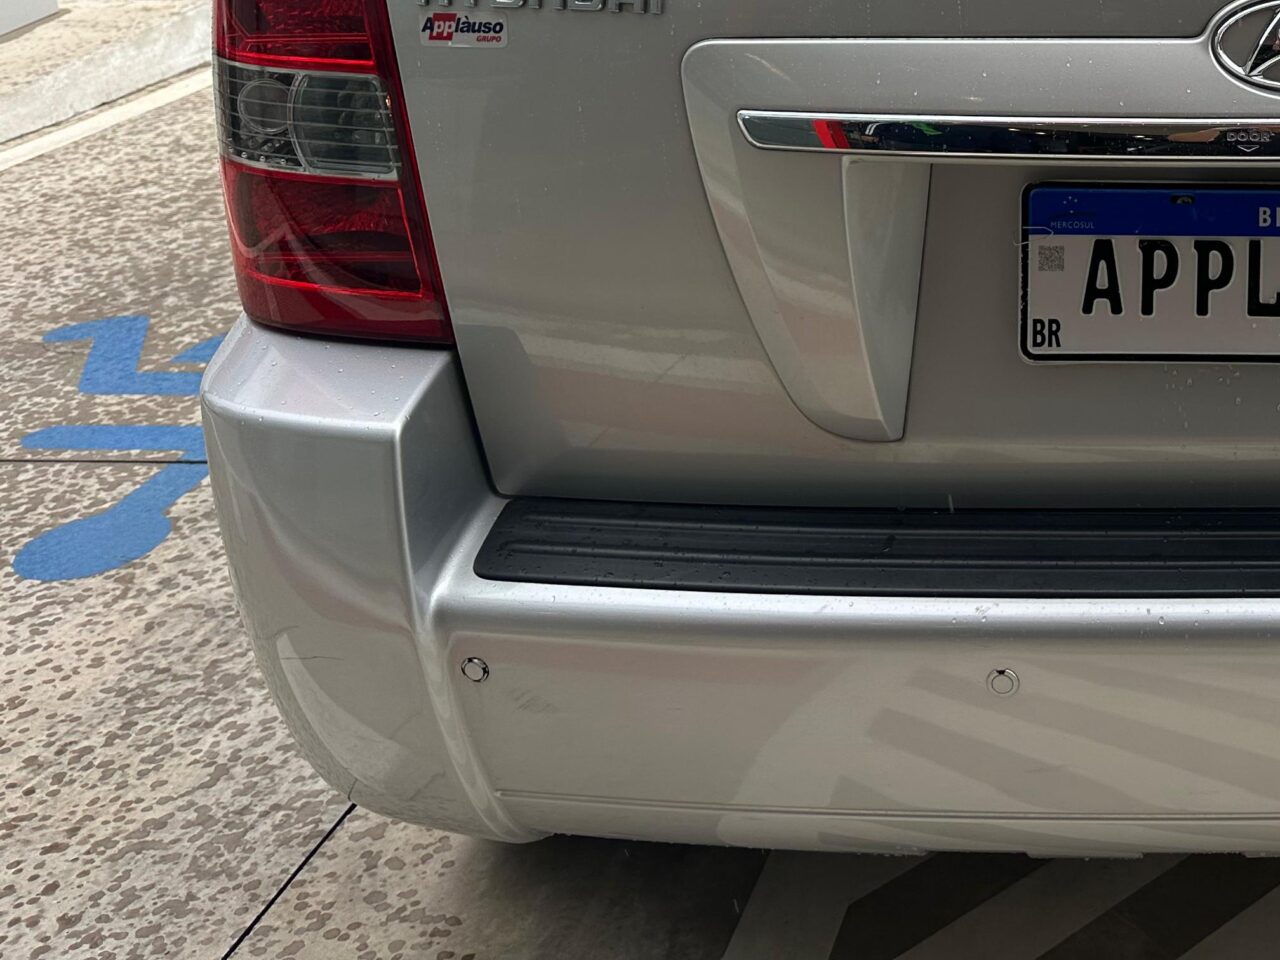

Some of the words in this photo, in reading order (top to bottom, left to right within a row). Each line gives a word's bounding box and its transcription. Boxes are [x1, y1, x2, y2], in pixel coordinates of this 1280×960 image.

[476, 34, 502, 43] GRUPO
[1227, 131, 1270, 142] DOOR
[1050, 221, 1095, 229] MERCOSUL
[1032, 318, 1062, 348] BR
